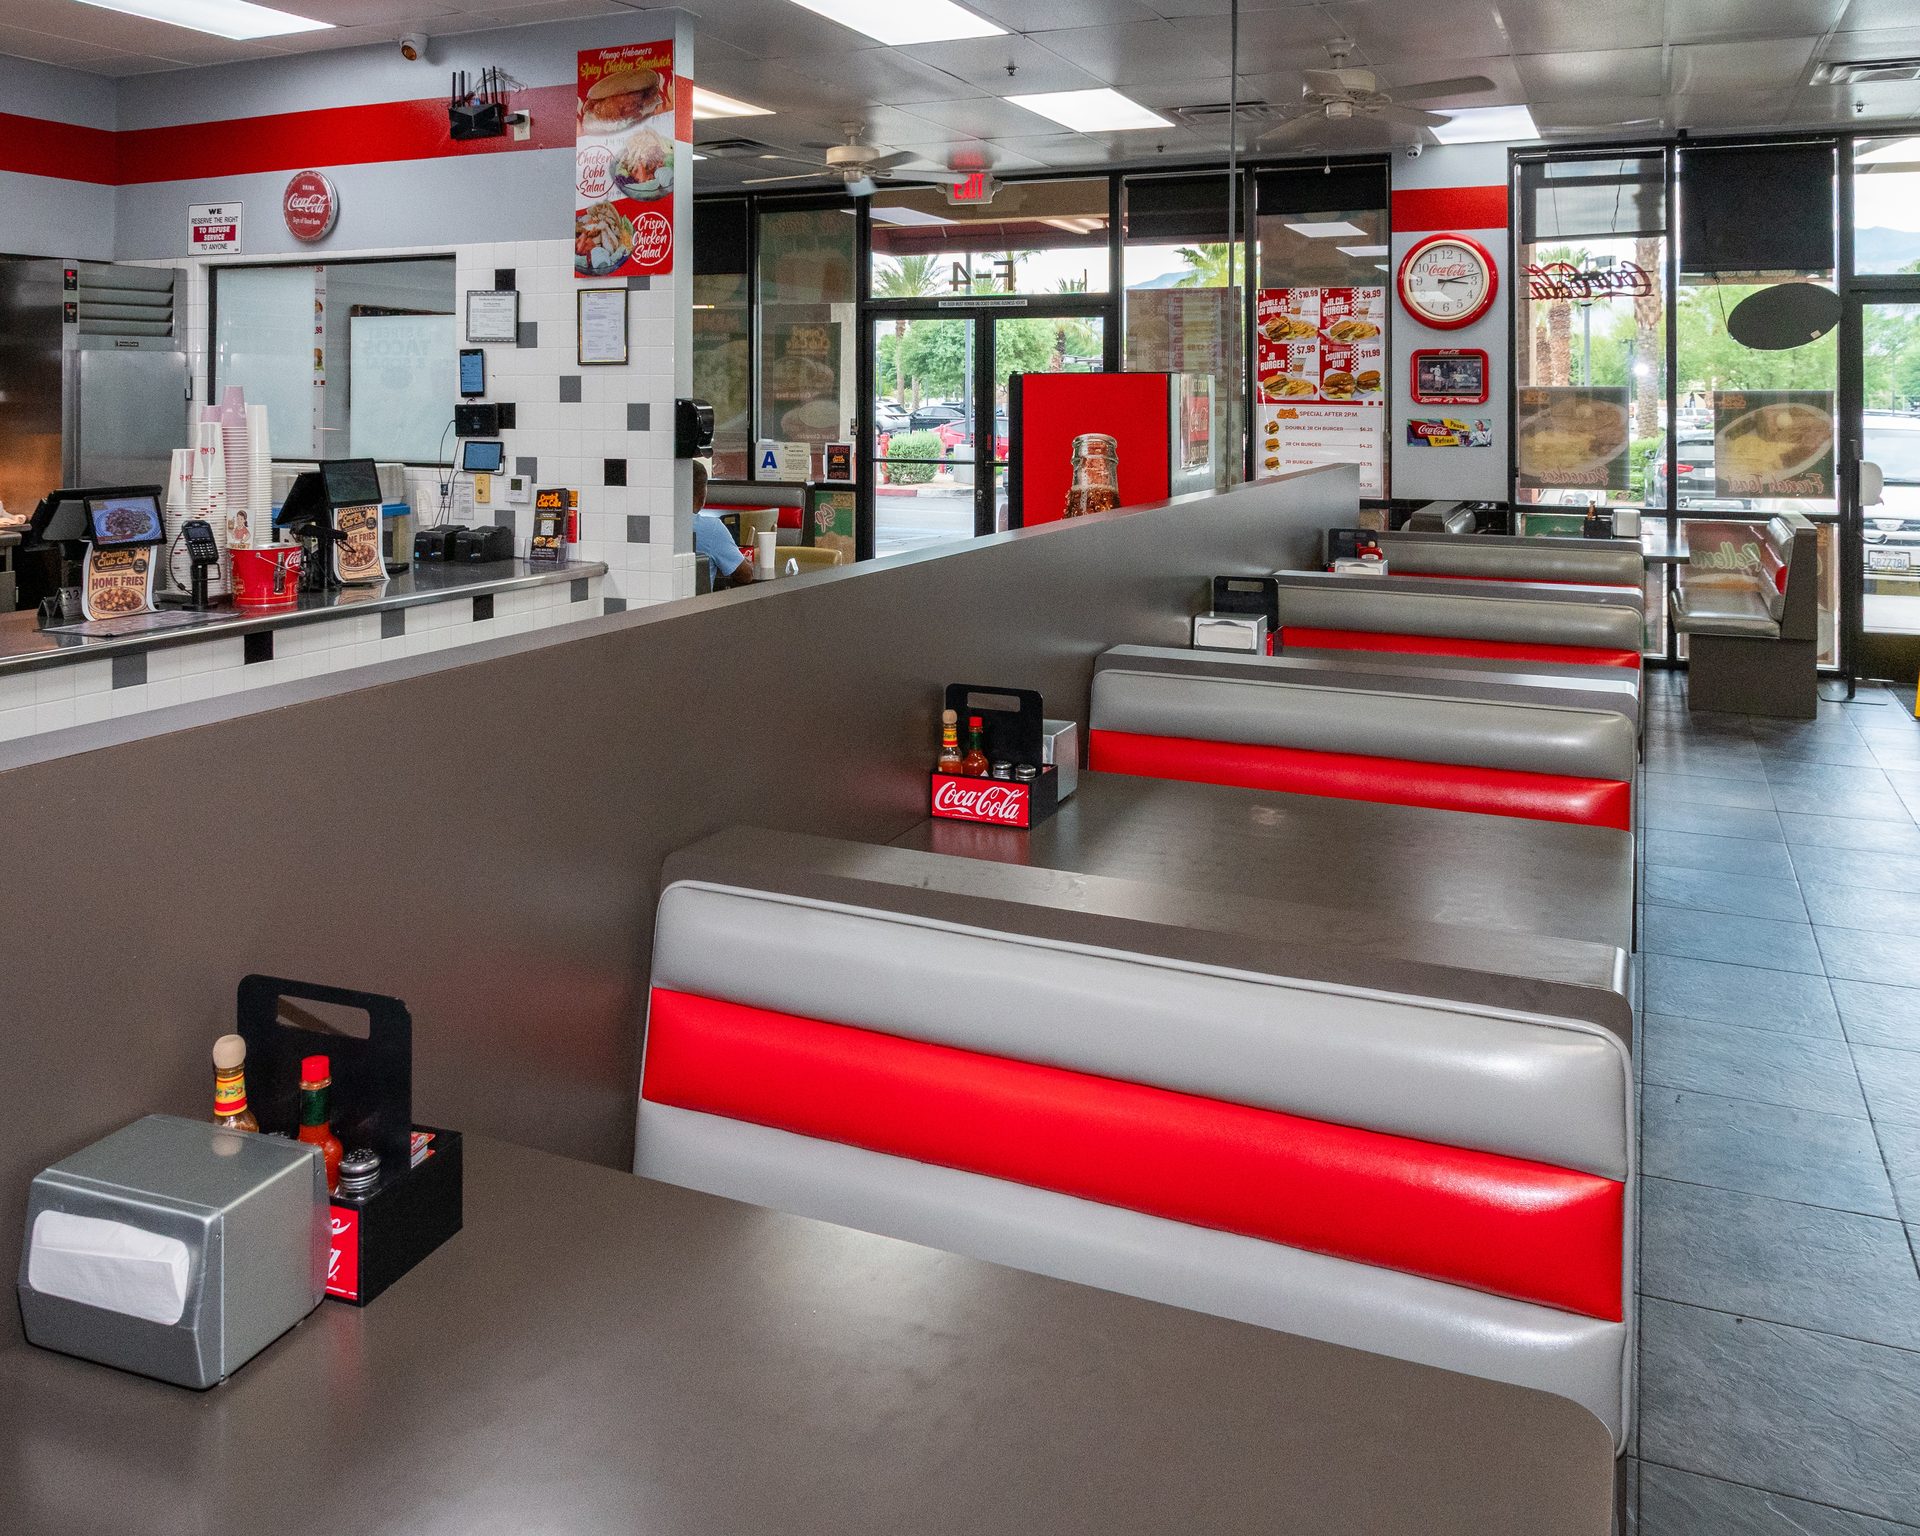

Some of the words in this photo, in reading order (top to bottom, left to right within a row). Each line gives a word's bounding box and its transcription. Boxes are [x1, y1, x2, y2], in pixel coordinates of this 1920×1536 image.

[599, 50, 620, 62] Mango
[621, 47, 652, 58] Habanero
[581, 62, 601, 80] Spicy
[603, 59, 633, 75] Chicken
[635, 53, 671, 70] Sandwich
[576, 151, 612, 165] Chicken
[583, 165, 605, 180] Cobb
[580, 180, 606, 194] Salad
[191, 216, 212, 224] RESERVE
[637, 215, 666, 234] Crispy
[199, 226, 207, 234] TO
[204, 233, 225, 241] SERVICE
[632, 231, 667, 246] Chicken
[635, 245, 662, 261] Salad
[1441, 250, 1453, 260] 12
[1429, 254, 1438, 264] 11
[1418, 263, 1429, 273] 10
[1428, 264, 1468, 276] Coca-Cola
[1468, 263, 1474, 272] 2
[1416, 276, 1423, 286] 9
[1471, 276, 1478, 286] 3
[1298, 289, 1319, 299] $10.99
[1362, 289, 1381, 300] $8.99
[1466, 289, 1473, 299] 4
[1442, 302, 1450, 312] 6
[1456, 299, 1463, 308] 5
[1322, 304, 1349, 317] BURGER
[1297, 344, 1316, 354] $7.99
[1360, 349, 1381, 359] $11.99
[1267, 352, 1276, 360] JR
[1325, 351, 1352, 362] COUNTRY
[1260, 359, 1286, 371] BURGER
[1332, 360, 1345, 368] DUO
[1418, 424, 1448, 435] Coca-Cola
[1450, 420, 1465, 430] Pause
[762, 451, 777, 469] A
[359, 531, 376, 542] FRIES
[101, 551, 128, 559] Country
[98, 558, 116, 567] Club
[92, 577, 119, 590] HOME
[121, 576, 145, 586] FRIES
[65, 590, 80, 600] 32
[934, 781, 1025, 819] Coca-Cola
